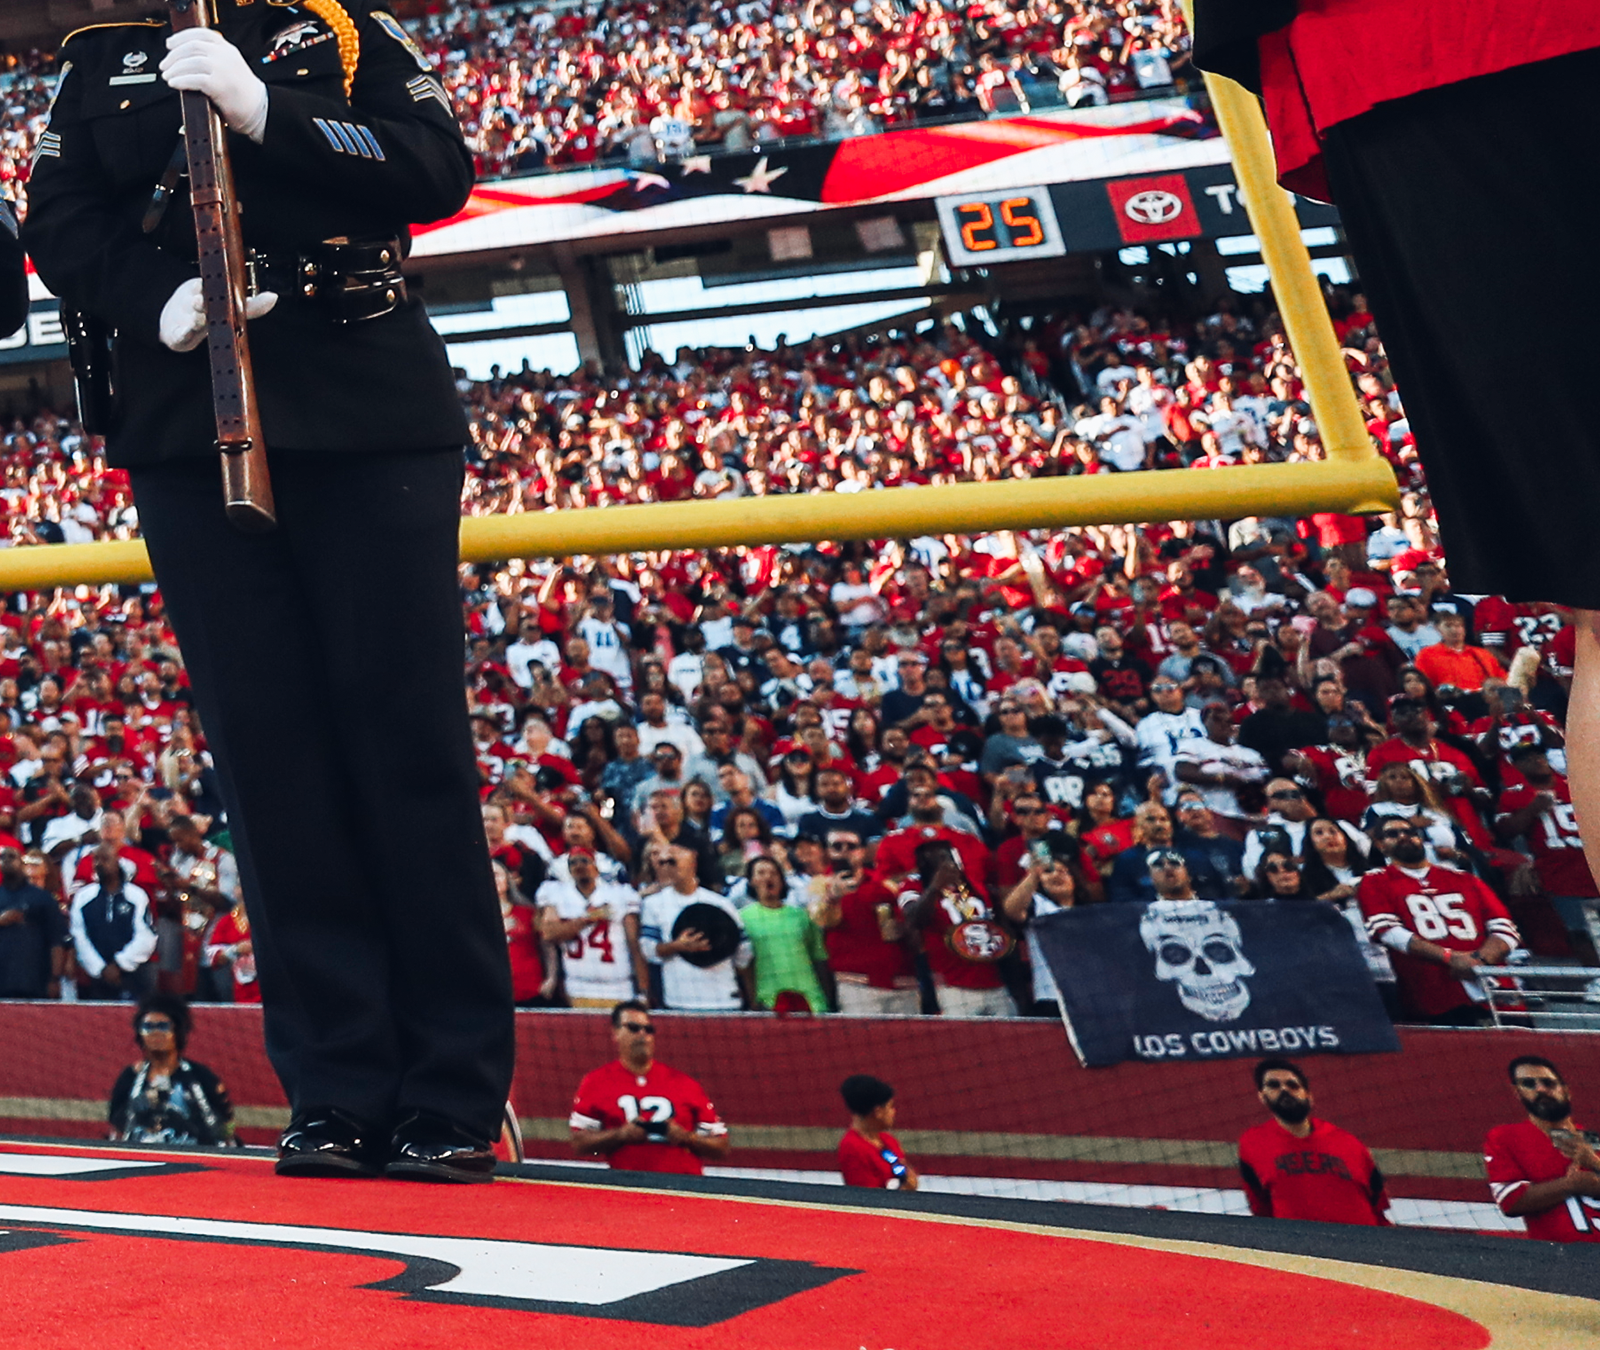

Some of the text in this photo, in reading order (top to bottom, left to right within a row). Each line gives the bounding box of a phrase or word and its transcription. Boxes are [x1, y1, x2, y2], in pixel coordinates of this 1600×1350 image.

[958, 197, 1045, 251] 25
[1404, 893, 1478, 941] 85
[1132, 1026, 1340, 1058] LOS COWBOYS
[616, 1094, 676, 1123] 12
